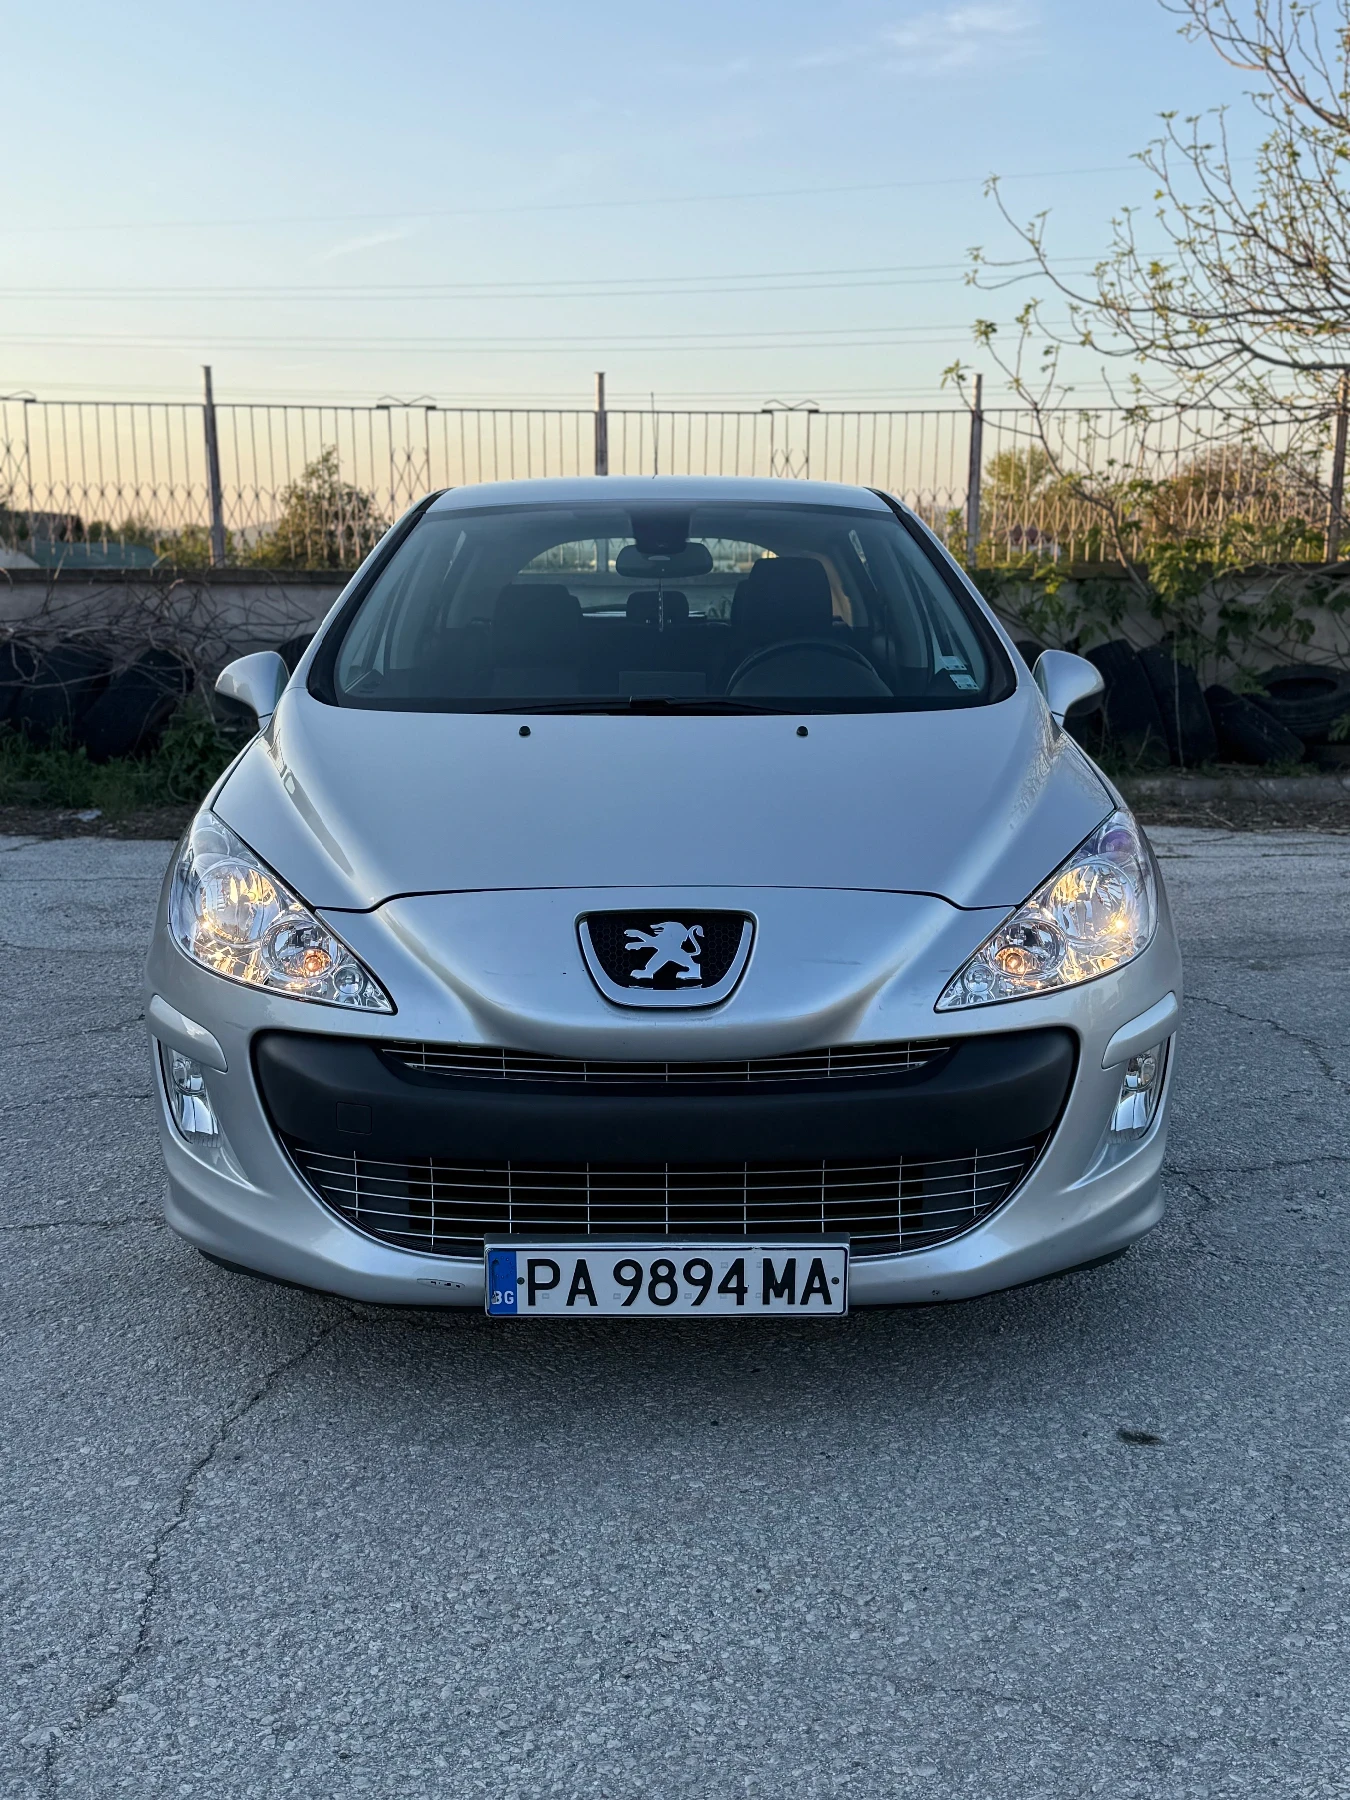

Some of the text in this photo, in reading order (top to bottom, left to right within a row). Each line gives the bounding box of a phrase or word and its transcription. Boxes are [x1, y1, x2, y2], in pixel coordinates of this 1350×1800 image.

[491, 1290, 514, 1305] BG
[527, 1258, 833, 1306] PA 9894 MA
